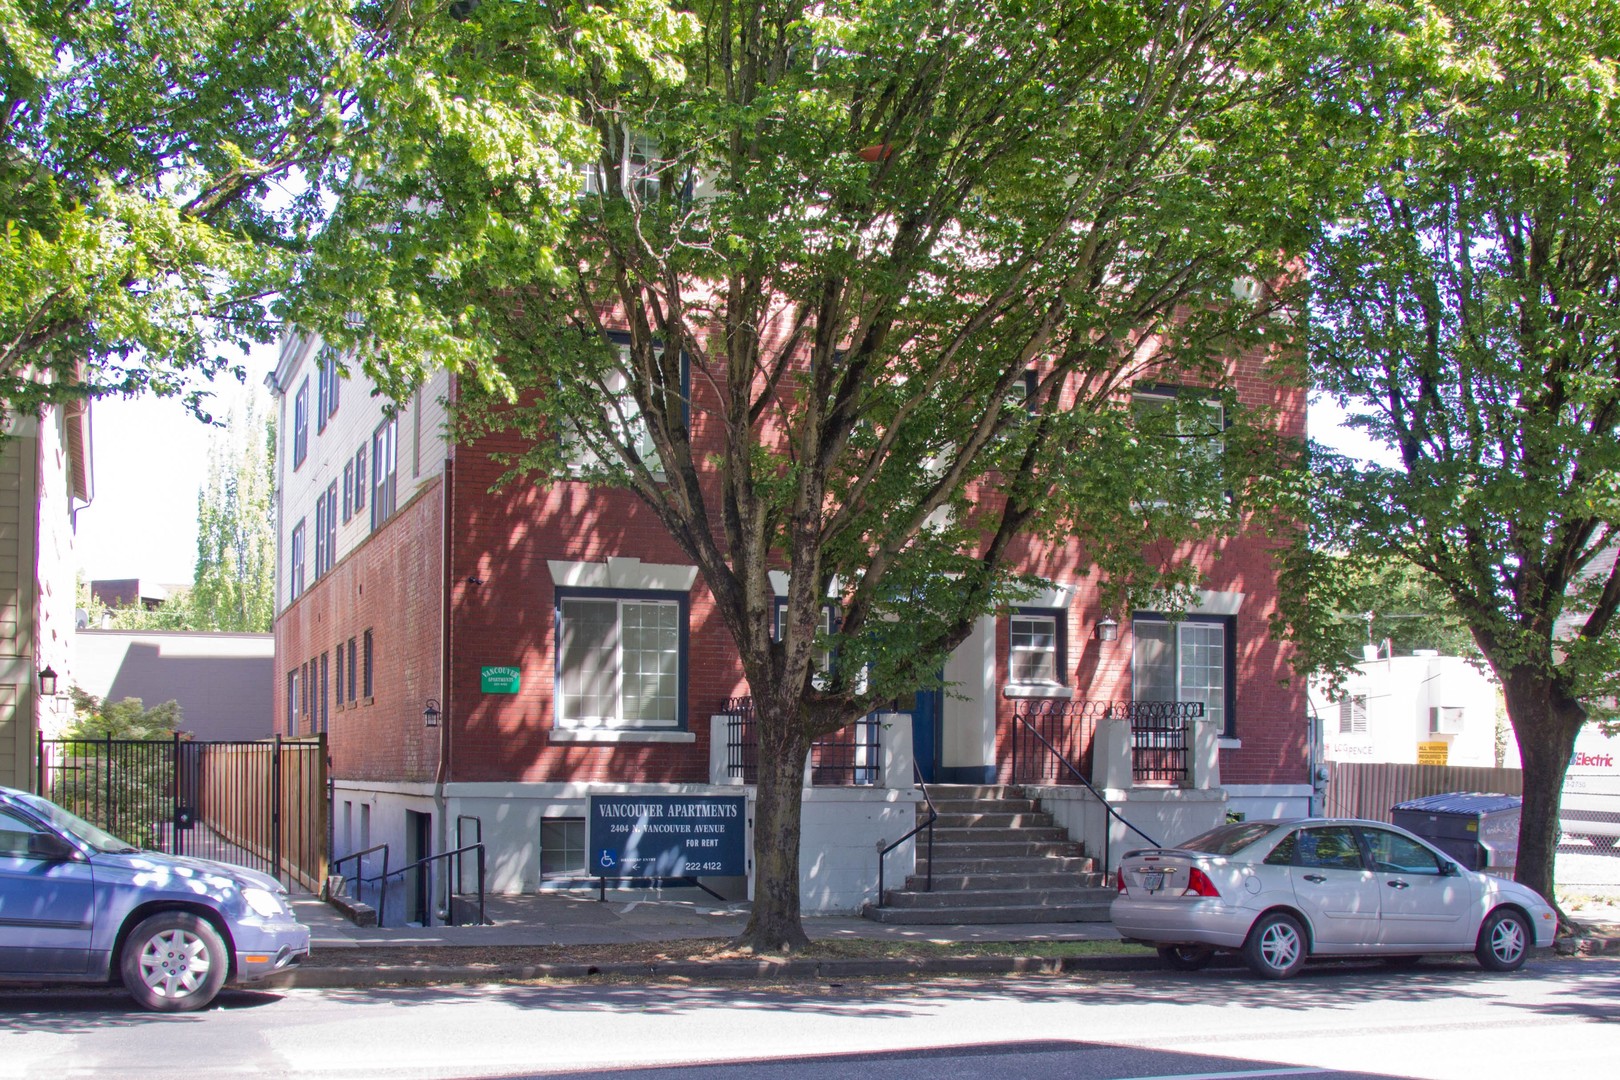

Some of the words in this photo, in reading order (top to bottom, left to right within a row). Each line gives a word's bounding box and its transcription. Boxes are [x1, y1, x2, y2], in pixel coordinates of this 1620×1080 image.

[482, 666, 519, 679] VANCOUVER
[1576, 752, 1614, 767] Electric
[599, 804, 664, 818] VANCOUVER
[668, 804, 738, 818] APARTMENTS
[610, 824, 629, 833] 2404
[632, 824, 641, 833] N.
[644, 824, 691, 833] VANCOUVER
[694, 824, 725, 833] AVENUE
[686, 839, 699, 848] FOR
[702, 838, 718, 847] RENT
[686, 862, 700, 871] 222
[702, 862, 722, 870] 4122
